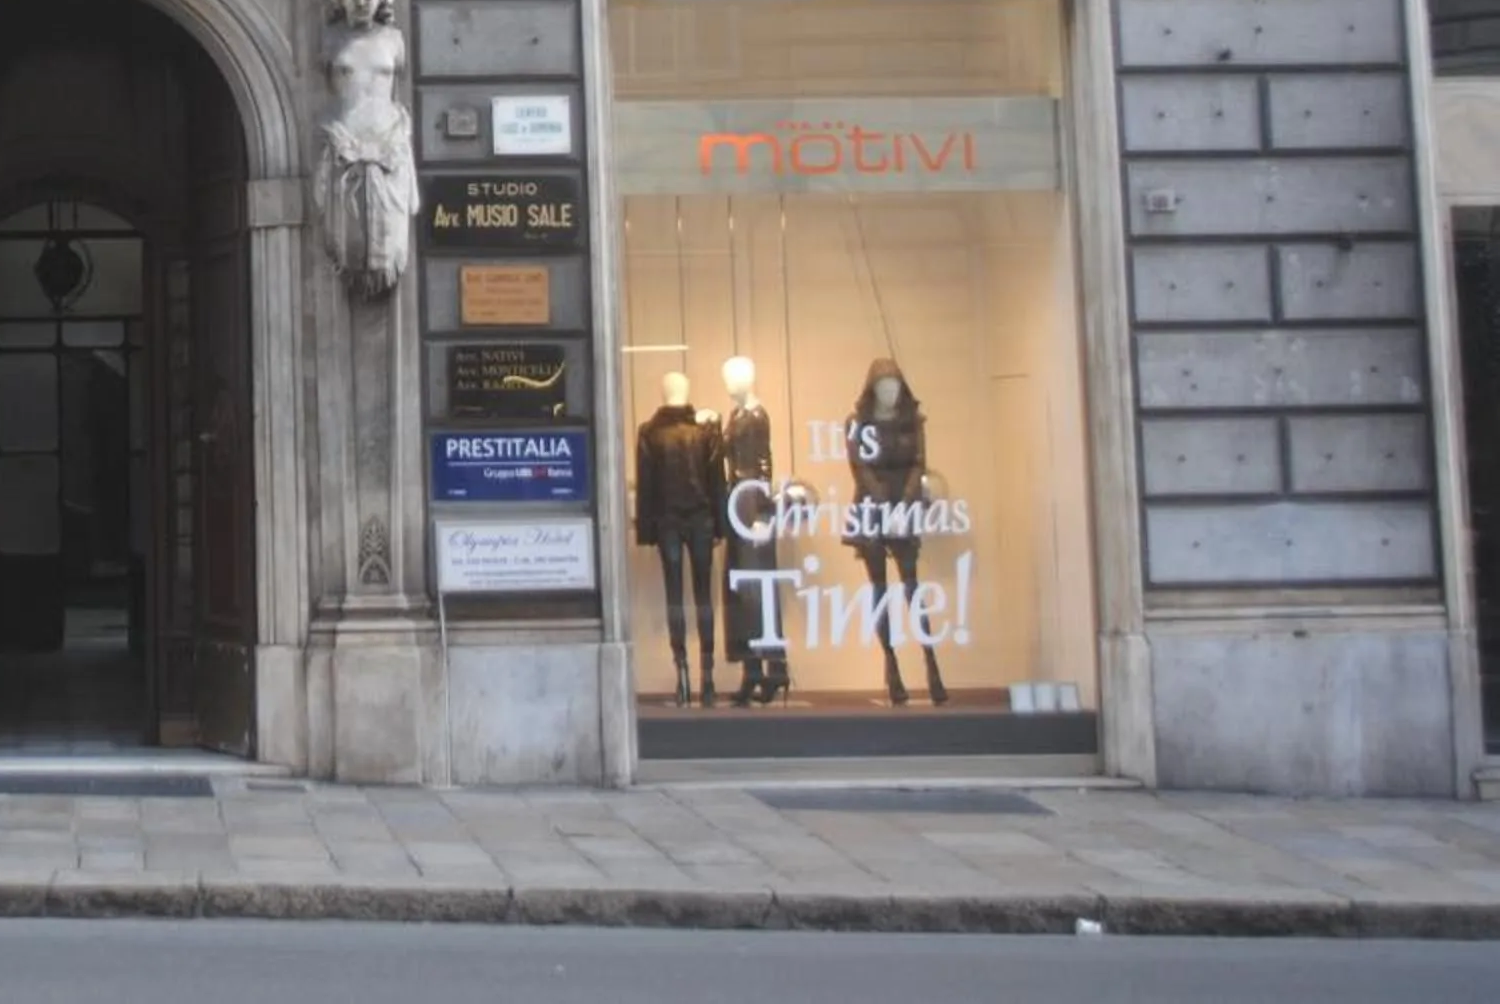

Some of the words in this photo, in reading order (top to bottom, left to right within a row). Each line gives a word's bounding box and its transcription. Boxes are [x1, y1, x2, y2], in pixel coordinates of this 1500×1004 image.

[467, 181, 538, 196] STUDIO
[527, 202, 573, 227] SALE
[446, 437, 571, 457] PRESTITALIA
[807, 420, 880, 462] It's
[727, 478, 971, 541] Christmas
[729, 551, 973, 649] Time!
